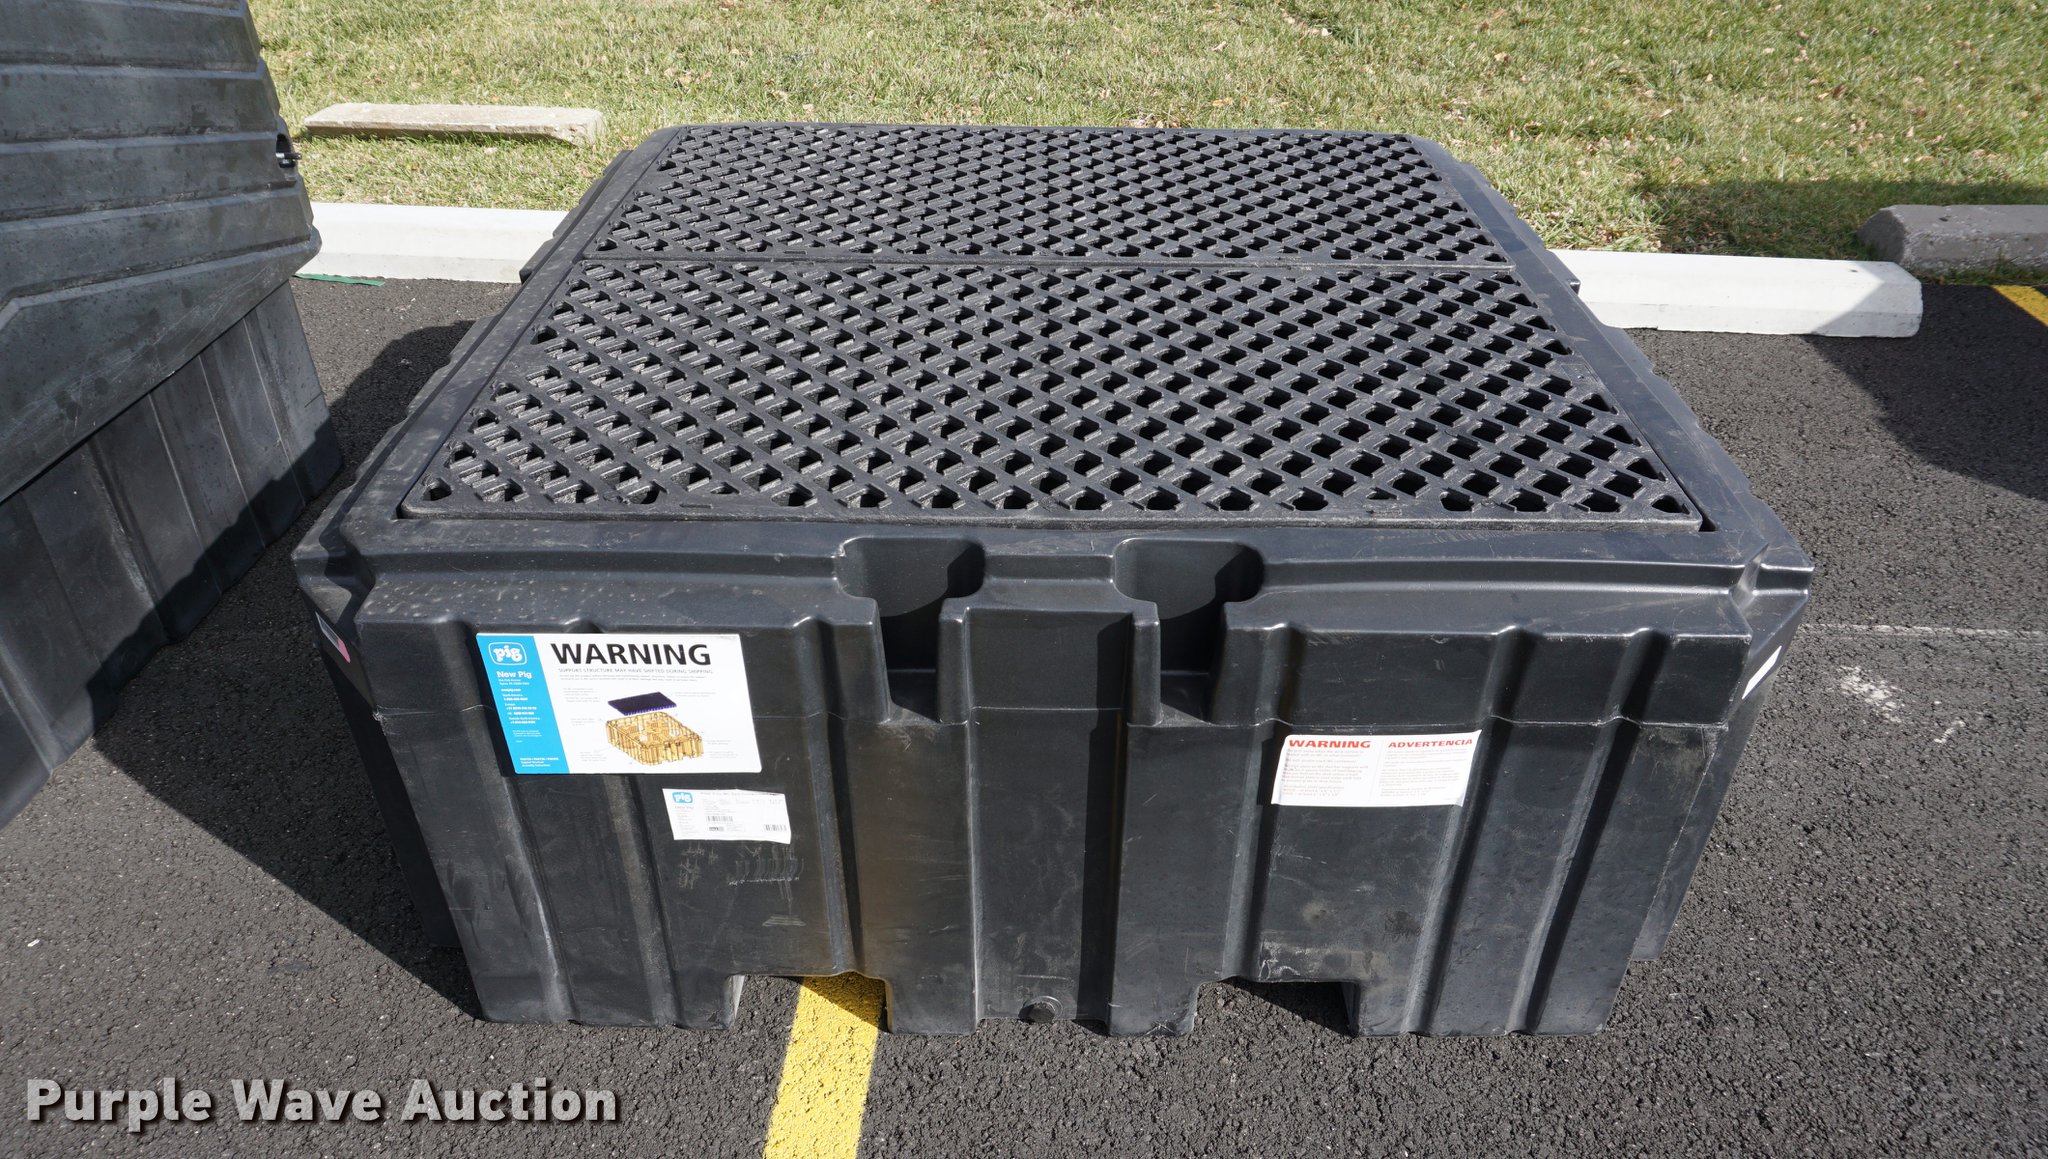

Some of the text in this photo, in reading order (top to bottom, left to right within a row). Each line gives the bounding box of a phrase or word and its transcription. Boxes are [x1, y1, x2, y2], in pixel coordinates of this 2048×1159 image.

[493, 645, 522, 662] pig
[550, 643, 711, 665] WARNING
[518, 671, 533, 680] Pig
[1289, 740, 1371, 748] WARNING
[1388, 739, 1473, 748] ADVERTENCIA
